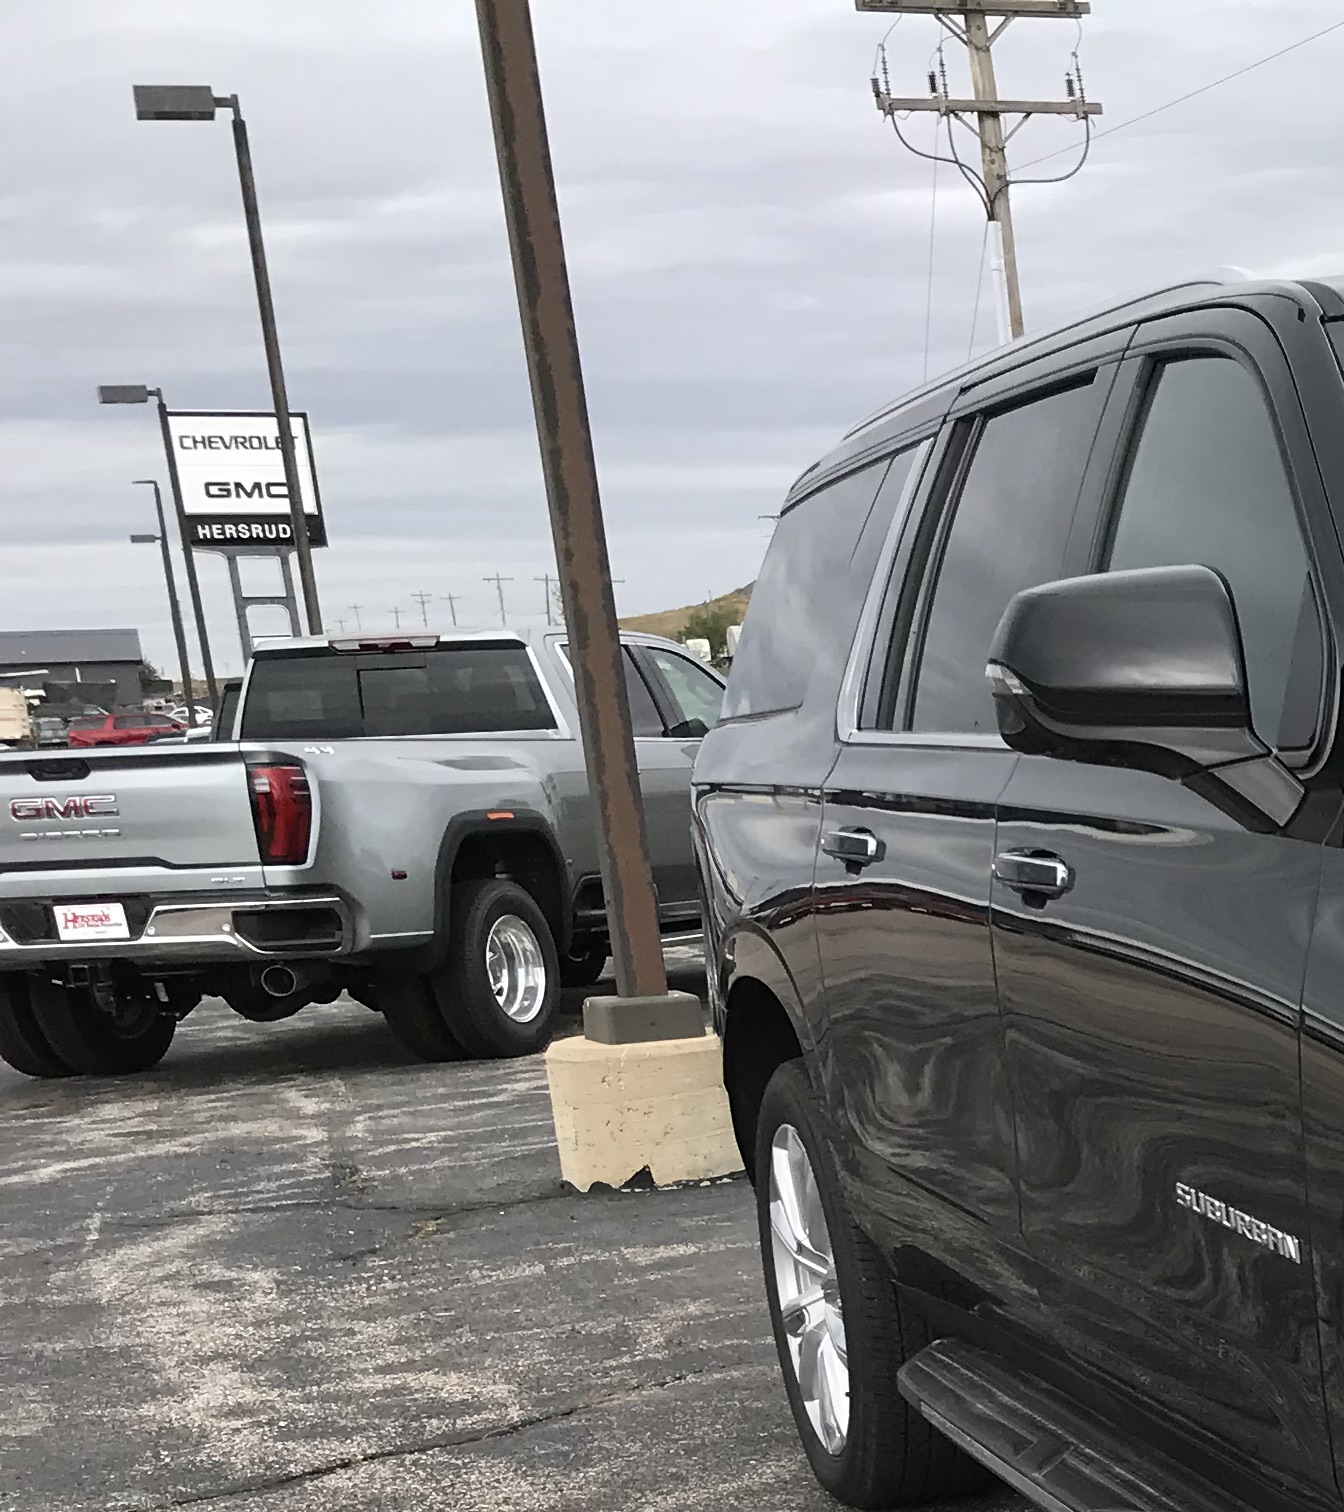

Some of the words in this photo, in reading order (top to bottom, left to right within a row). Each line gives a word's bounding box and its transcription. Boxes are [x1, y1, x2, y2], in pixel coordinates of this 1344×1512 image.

[204, 481, 290, 499] GMC
[9, 794, 120, 822] GMC
[1176, 1181, 1301, 1264] SUBURBAN
